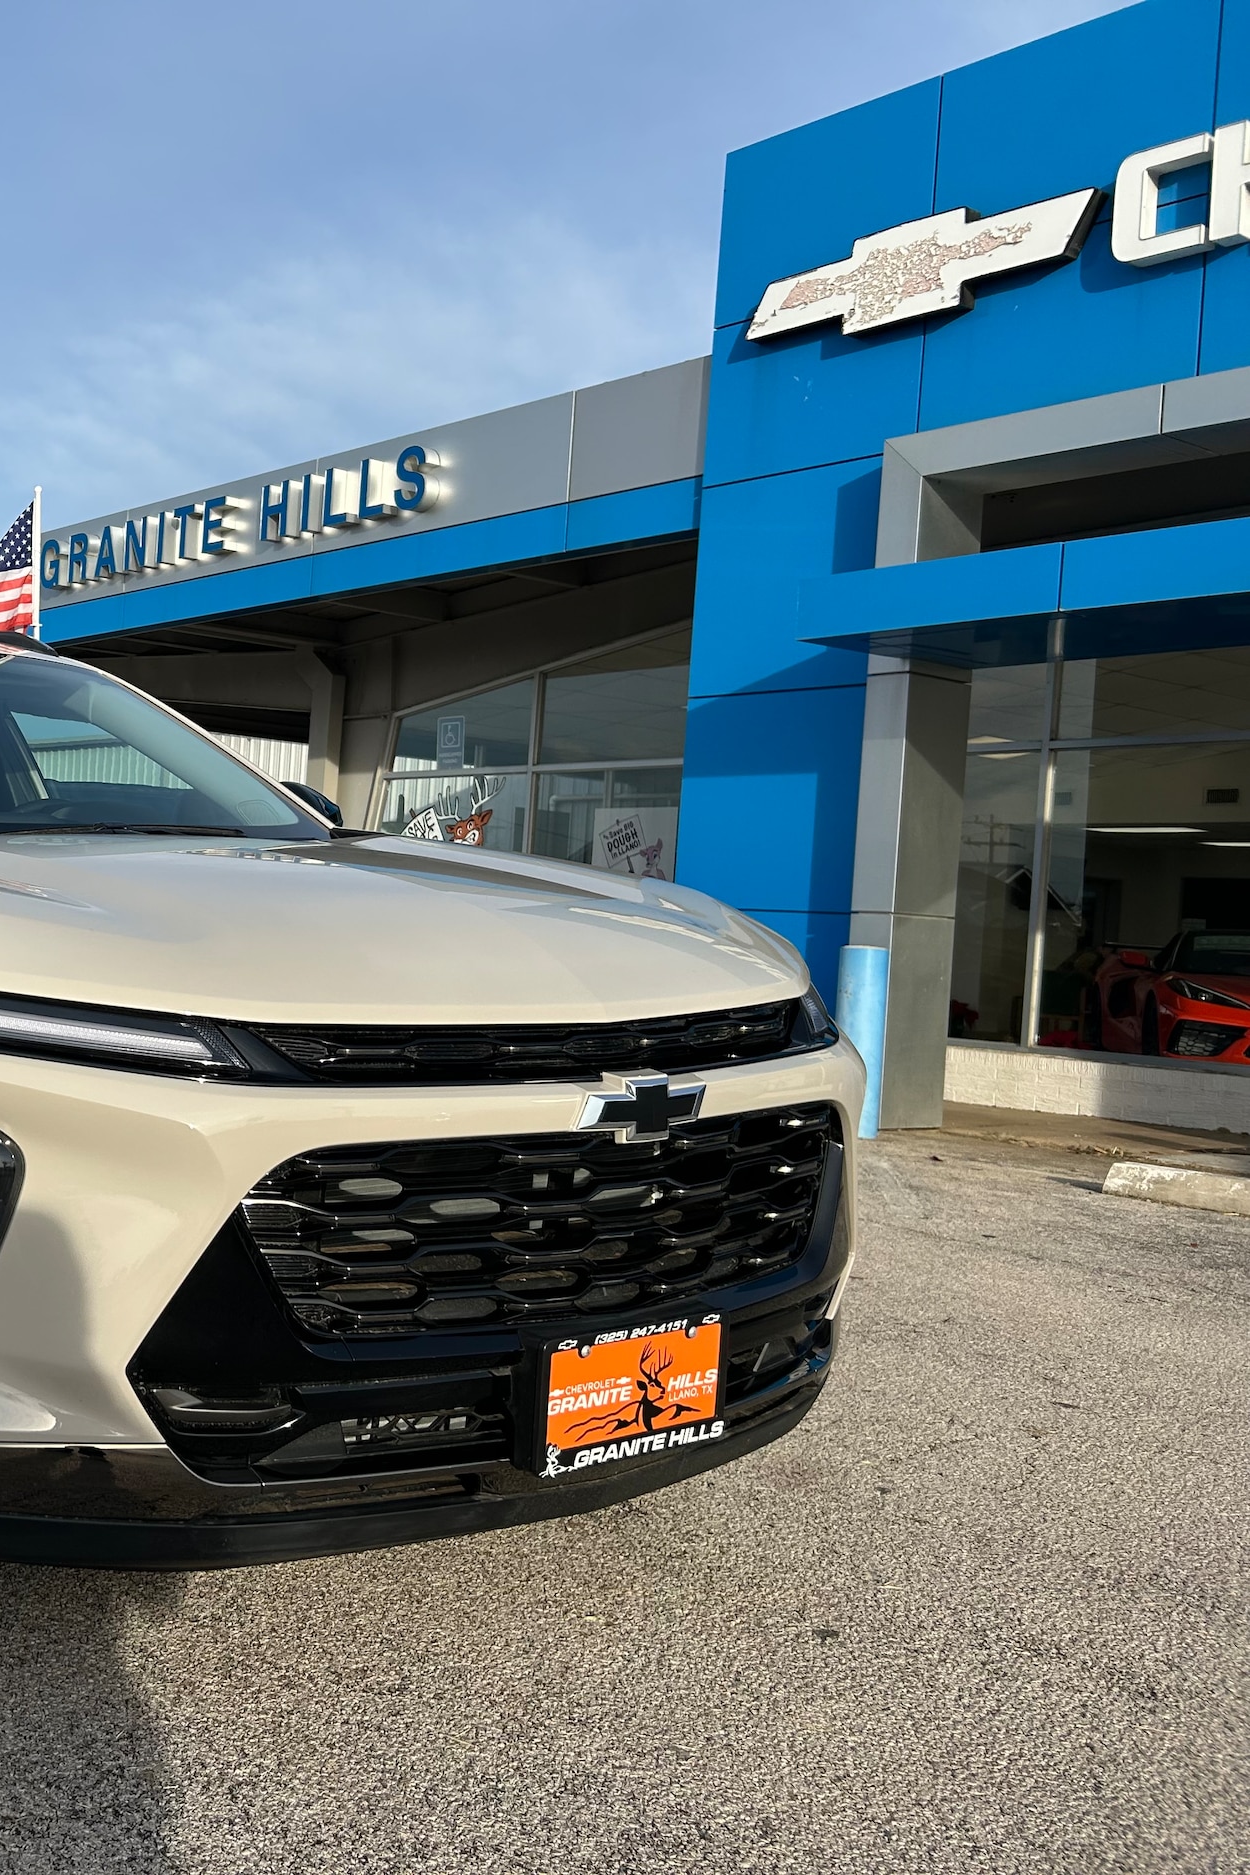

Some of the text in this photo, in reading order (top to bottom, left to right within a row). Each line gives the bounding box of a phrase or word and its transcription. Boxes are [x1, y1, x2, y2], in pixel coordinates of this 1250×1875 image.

[40, 445, 440, 590] GRANITE HILLS
[407, 811, 435, 838] SAVE
[606, 827, 639, 853] DOUGH
[594, 1318, 688, 1345] (325) 247-4151
[547, 1368, 719, 1416] GRANITE HILLS
[565, 1378, 616, 1395] CHEVROLET
[668, 1384, 713, 1402] LLANO, TX
[573, 1420, 725, 1468] GRANITE HILLS
